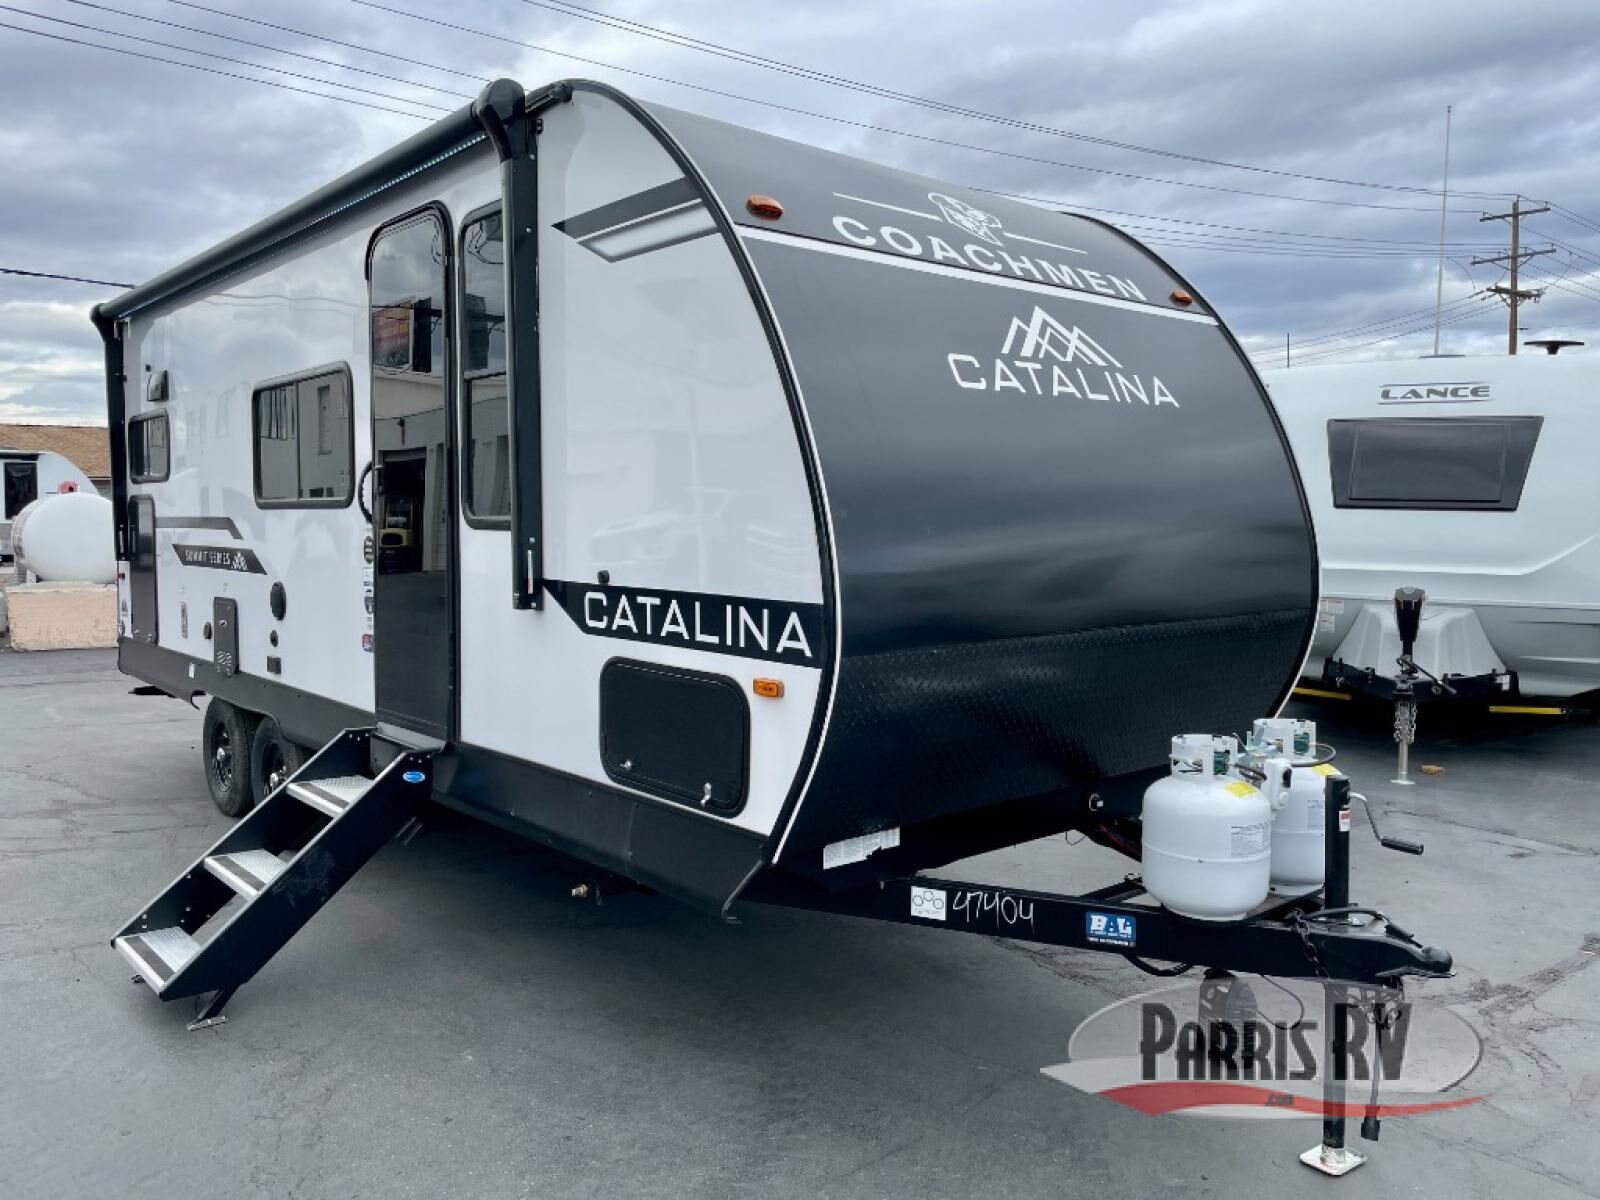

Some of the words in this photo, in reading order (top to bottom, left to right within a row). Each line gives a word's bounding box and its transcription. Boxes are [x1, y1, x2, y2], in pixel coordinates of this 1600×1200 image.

[832, 215, 1147, 301] COACHMEN
[947, 352, 1180, 409] CATALINA
[1381, 385, 1490, 399] LANCE
[583, 591, 813, 659] CATALINA
[953, 891, 1035, 934] 47404
